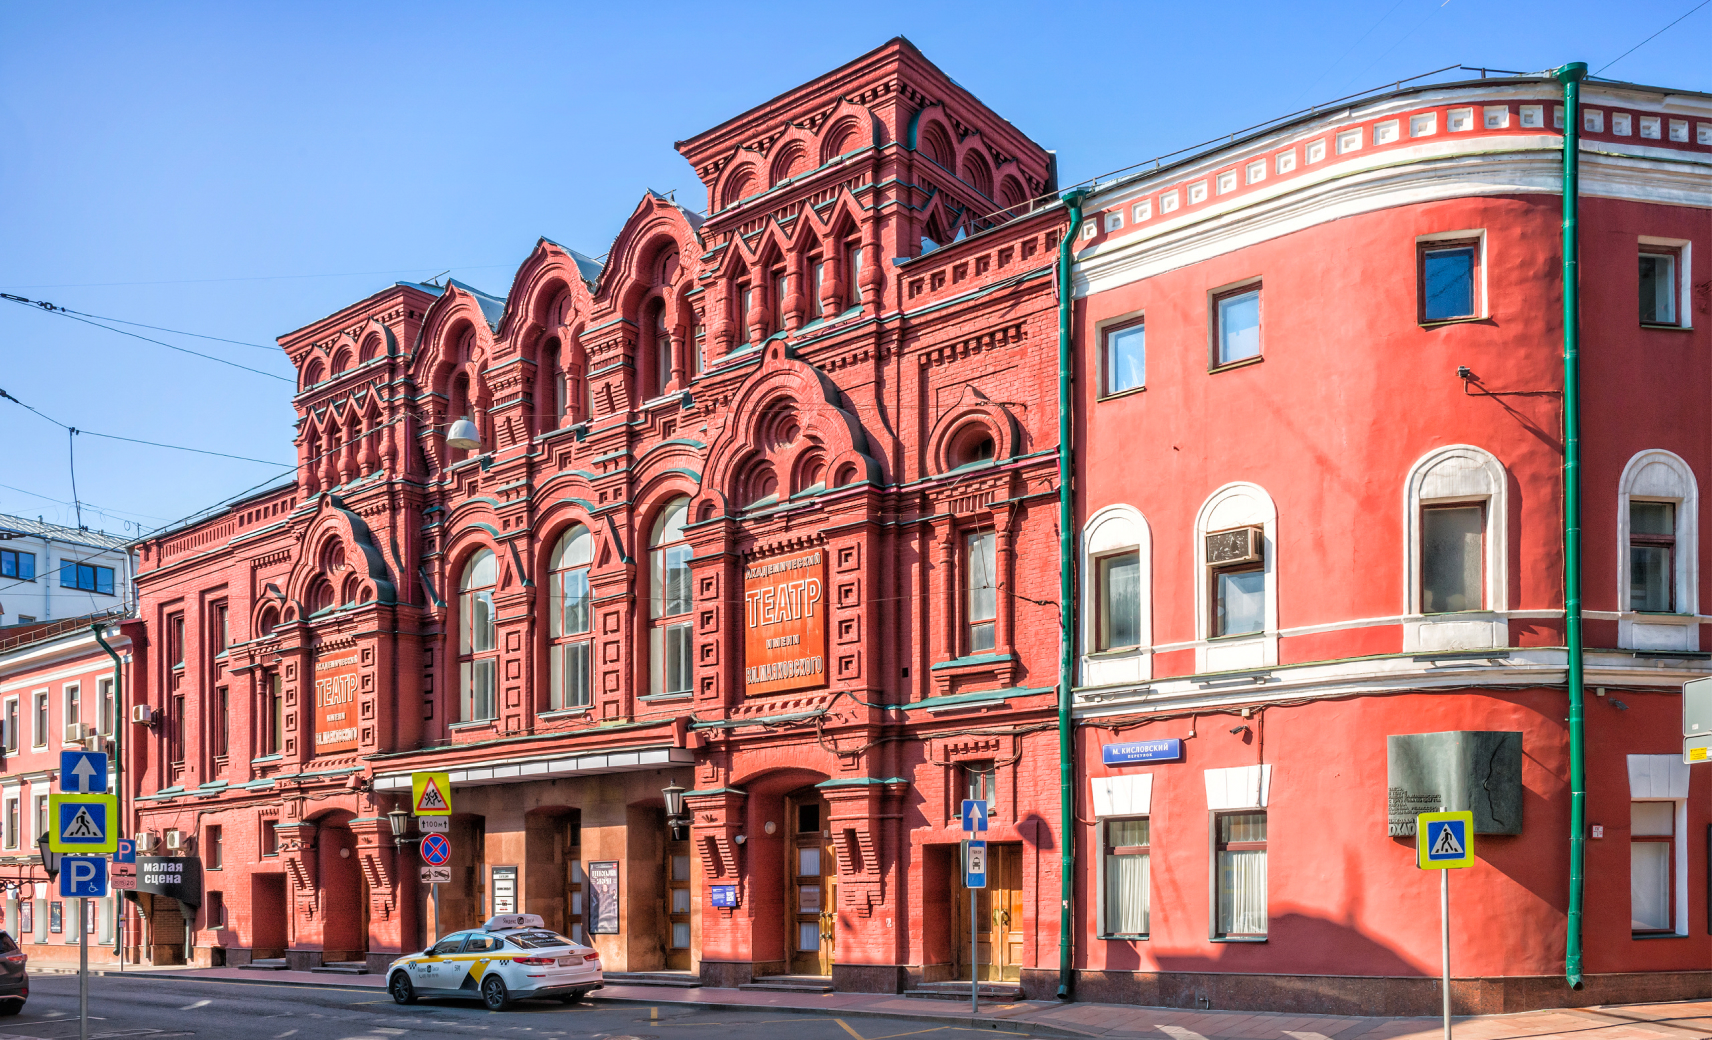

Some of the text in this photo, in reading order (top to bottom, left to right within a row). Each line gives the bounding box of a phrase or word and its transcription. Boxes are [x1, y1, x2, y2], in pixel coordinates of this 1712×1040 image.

[746, 553, 821, 579] АКАДЕМИЧЕСКИЙ
[746, 577, 823, 628] ТЕАТР
[766, 634, 800, 649] ИМЕНИ
[316, 673, 358, 707] ТЕАТР
[1121, 743, 1168, 754] КИСЛОВСКИЙ
[70, 860, 96, 893] P
[143, 862, 183, 872] малая
[144, 874, 182, 885] сцена
